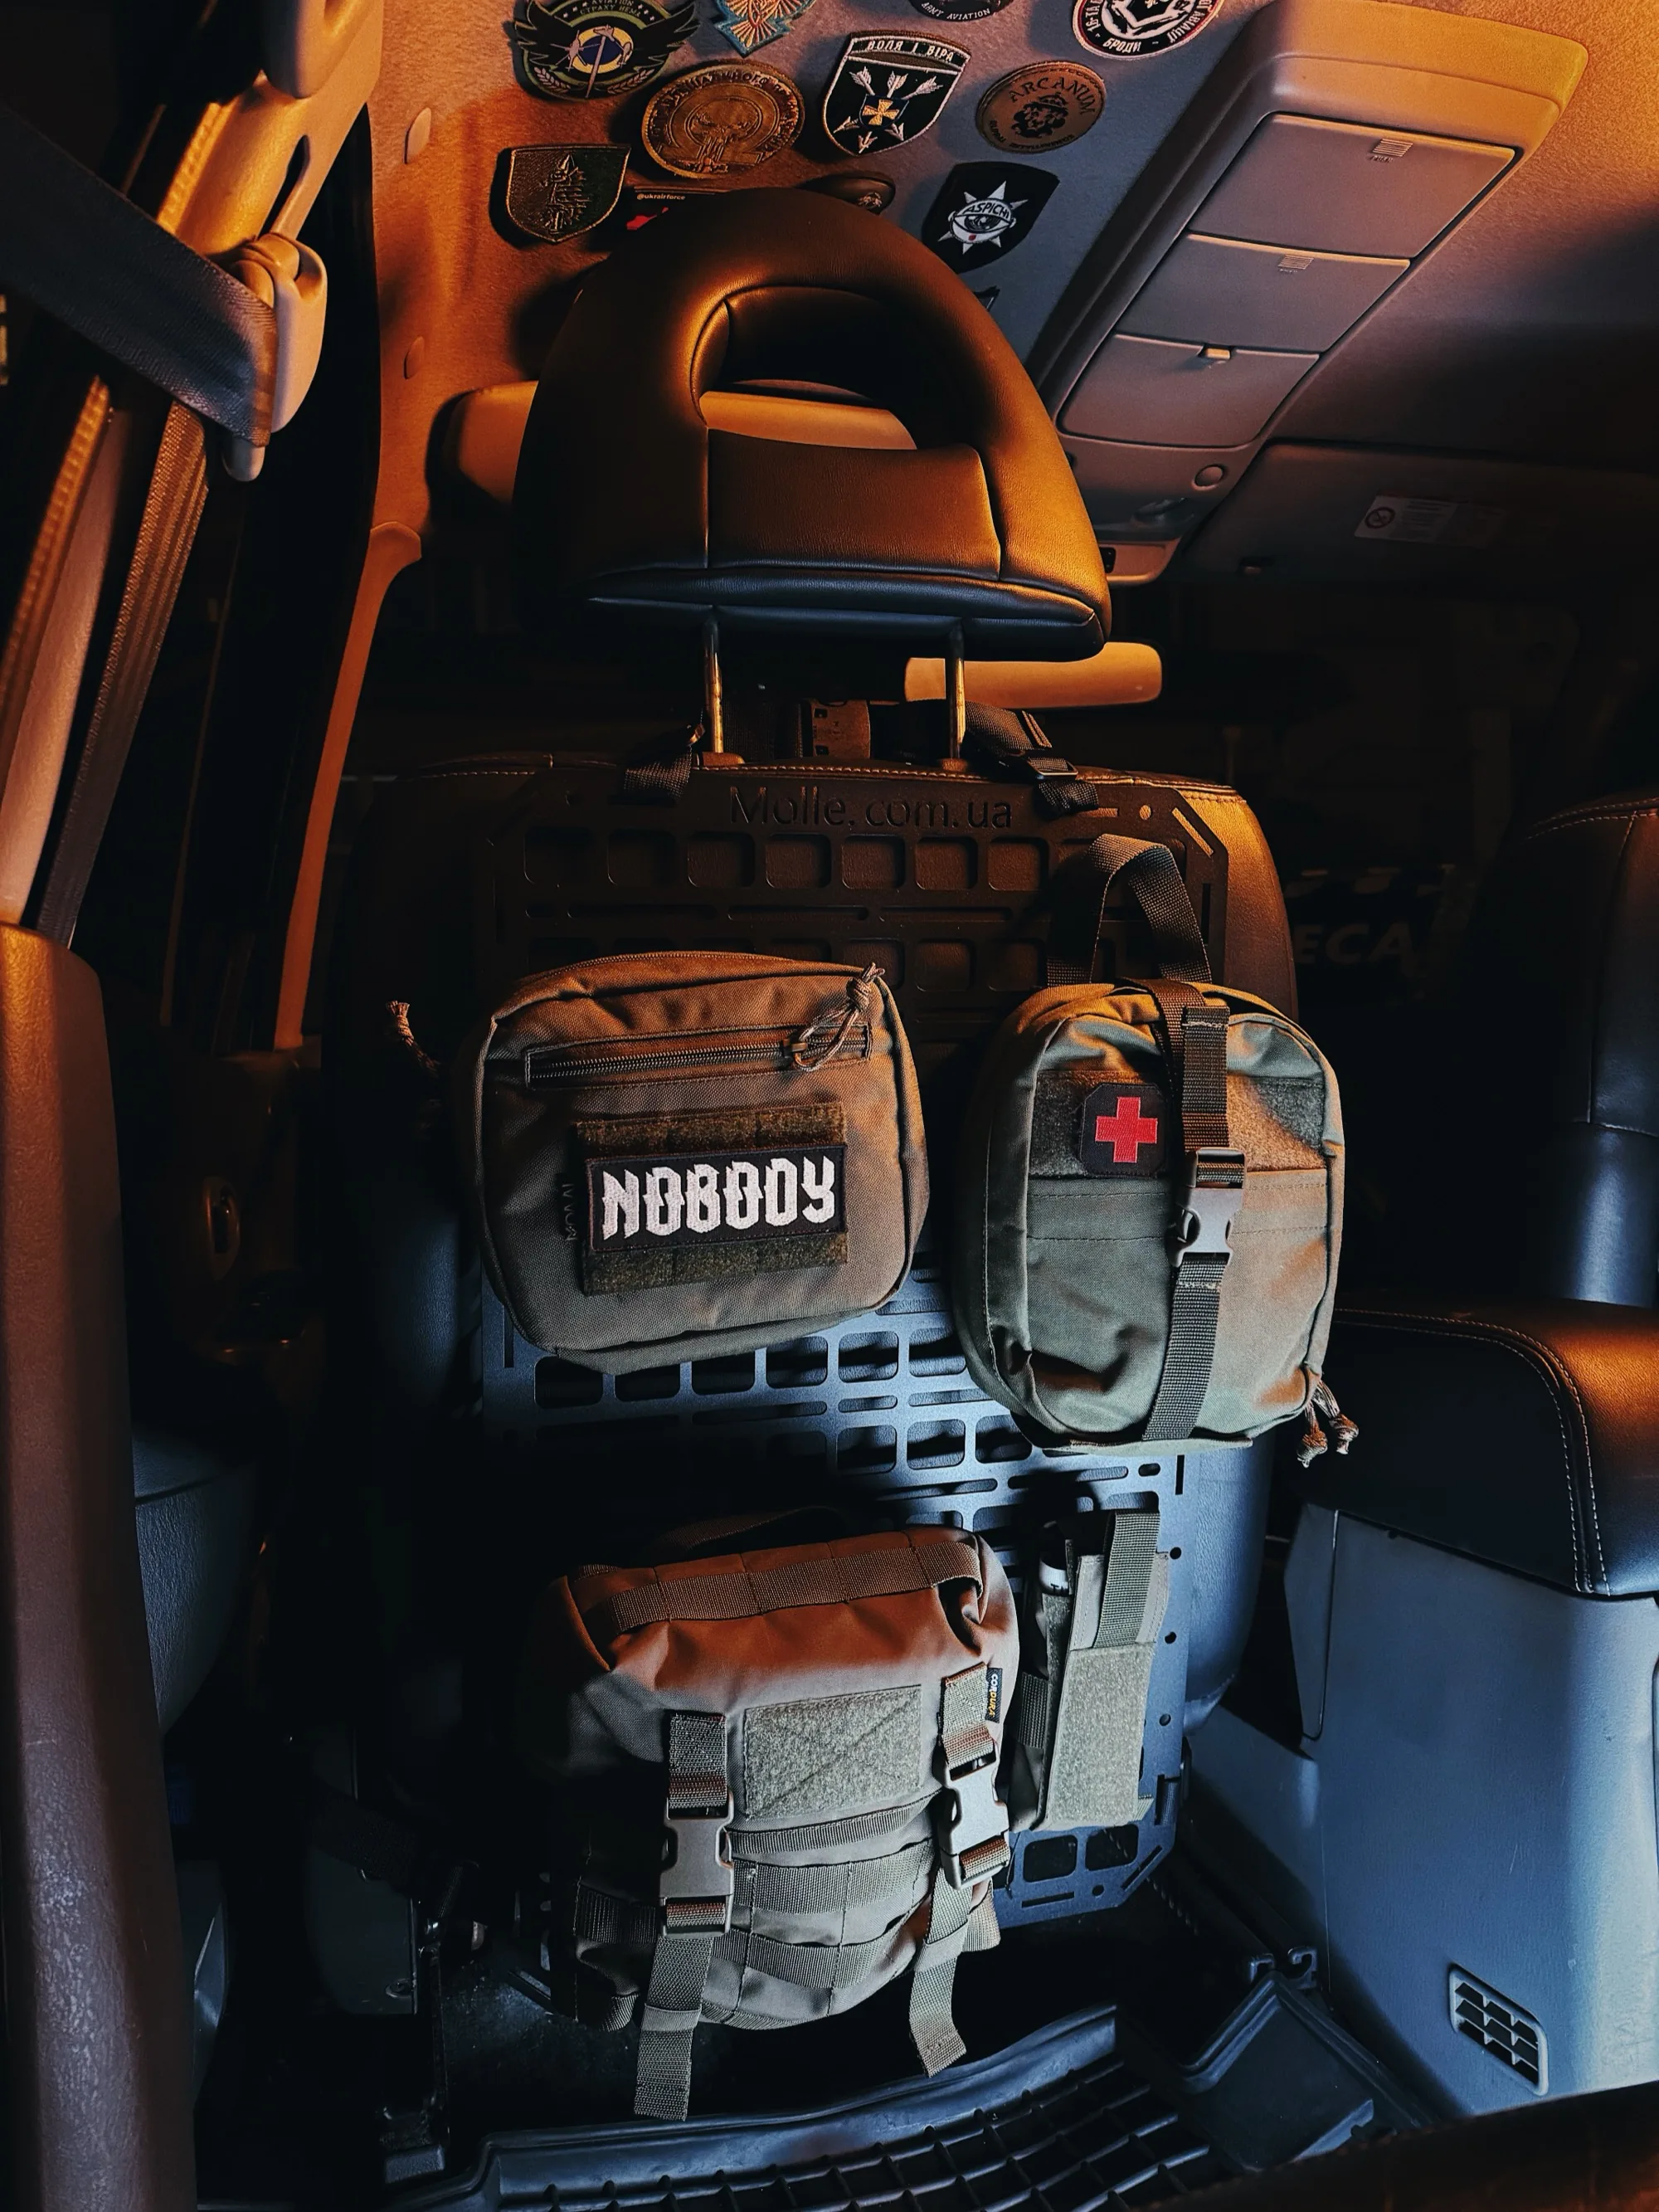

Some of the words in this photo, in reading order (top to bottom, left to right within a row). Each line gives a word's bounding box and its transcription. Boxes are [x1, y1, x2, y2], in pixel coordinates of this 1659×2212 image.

[921, 2, 944, 17] ARMY
[946, 7, 991, 20] AVIATION
[926, 45, 954, 62] ВІРА
[1102, 38, 1141, 53] БРОДИ
[1009, 76, 1096, 115] ARCANUM
[601, 1155, 836, 1241] NOBODY
[988, 1673, 999, 1718] CORDURA
